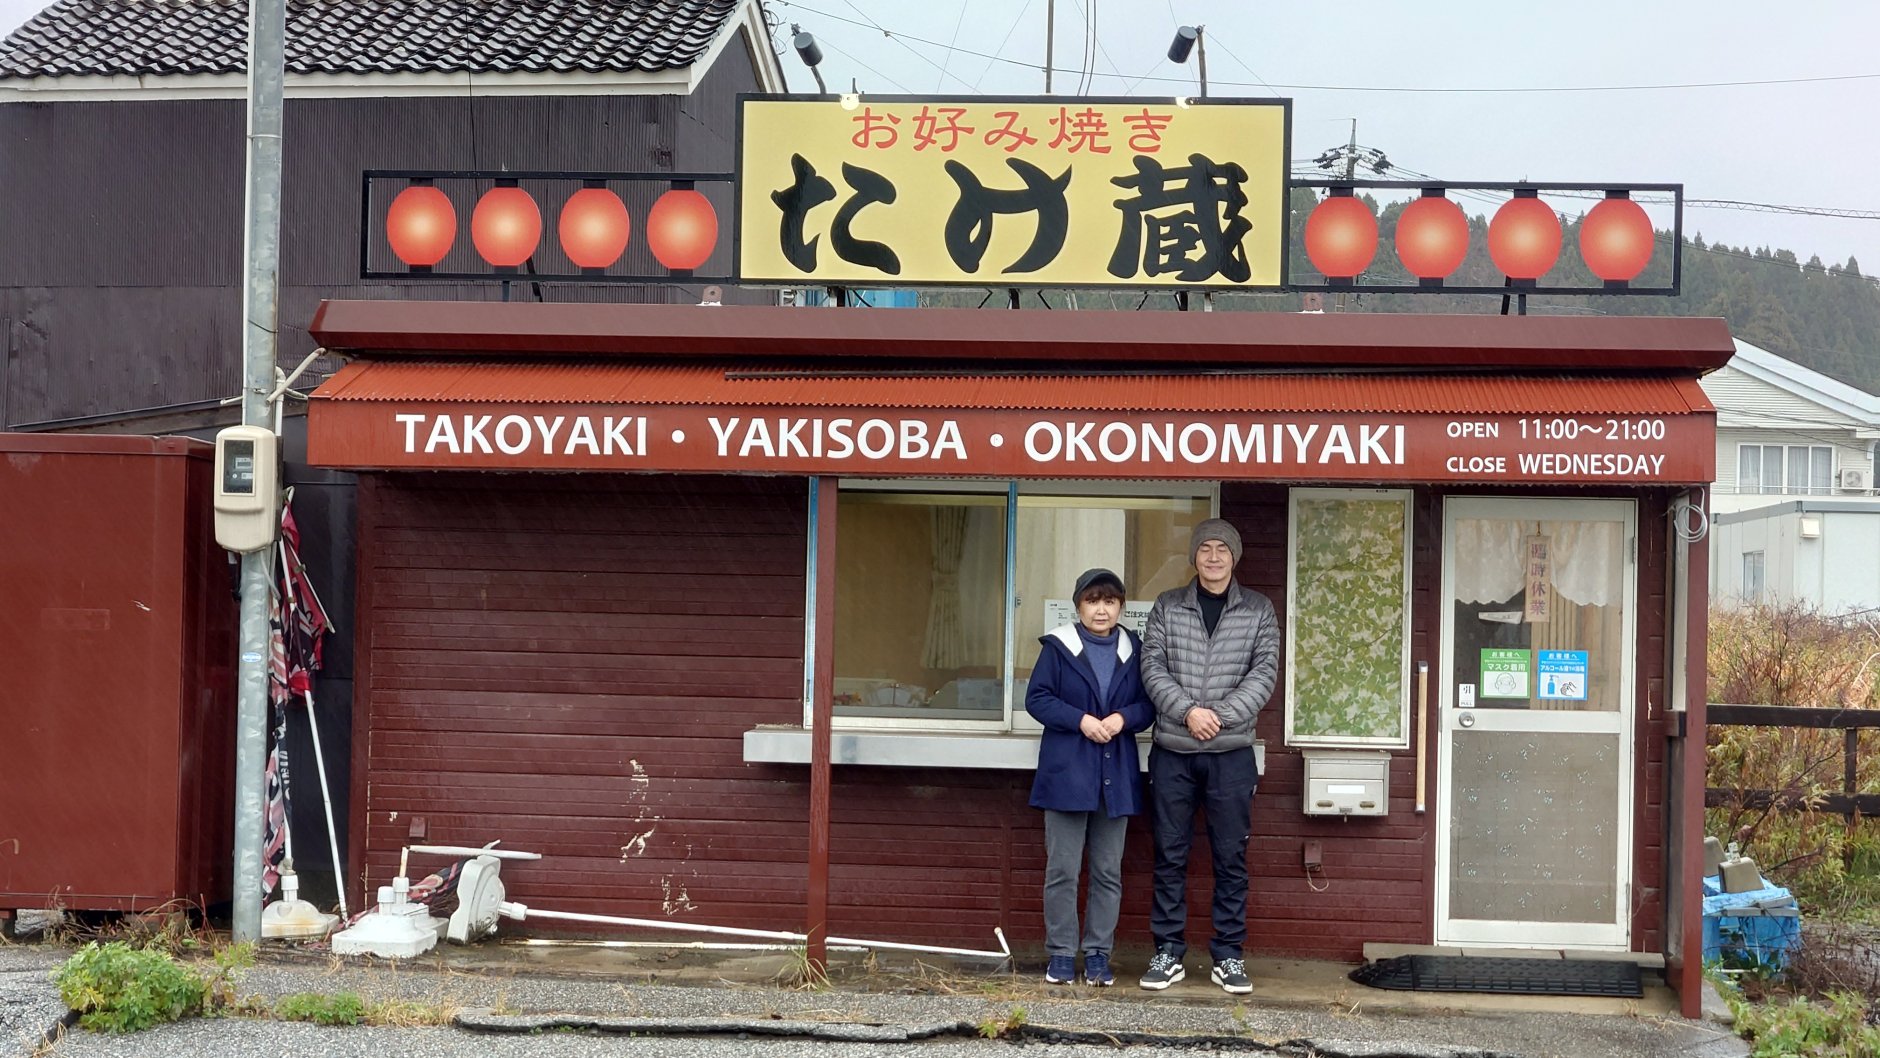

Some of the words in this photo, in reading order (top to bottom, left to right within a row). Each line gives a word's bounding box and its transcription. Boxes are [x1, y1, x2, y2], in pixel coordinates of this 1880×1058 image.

[851, 107, 1173, 154] お好み焼き
[770, 153, 1253, 283] たけ蔵
[395, 413, 647, 456] TAKOYAKI
[707, 416, 968, 461] YAKISOBA
[1024, 420, 1406, 465] OKONOMIYAKI
[1446, 421, 1499, 438] OPEN
[1446, 456, 1507, 473] CLOSE
[1518, 453, 1665, 476] WEDNESDAY
